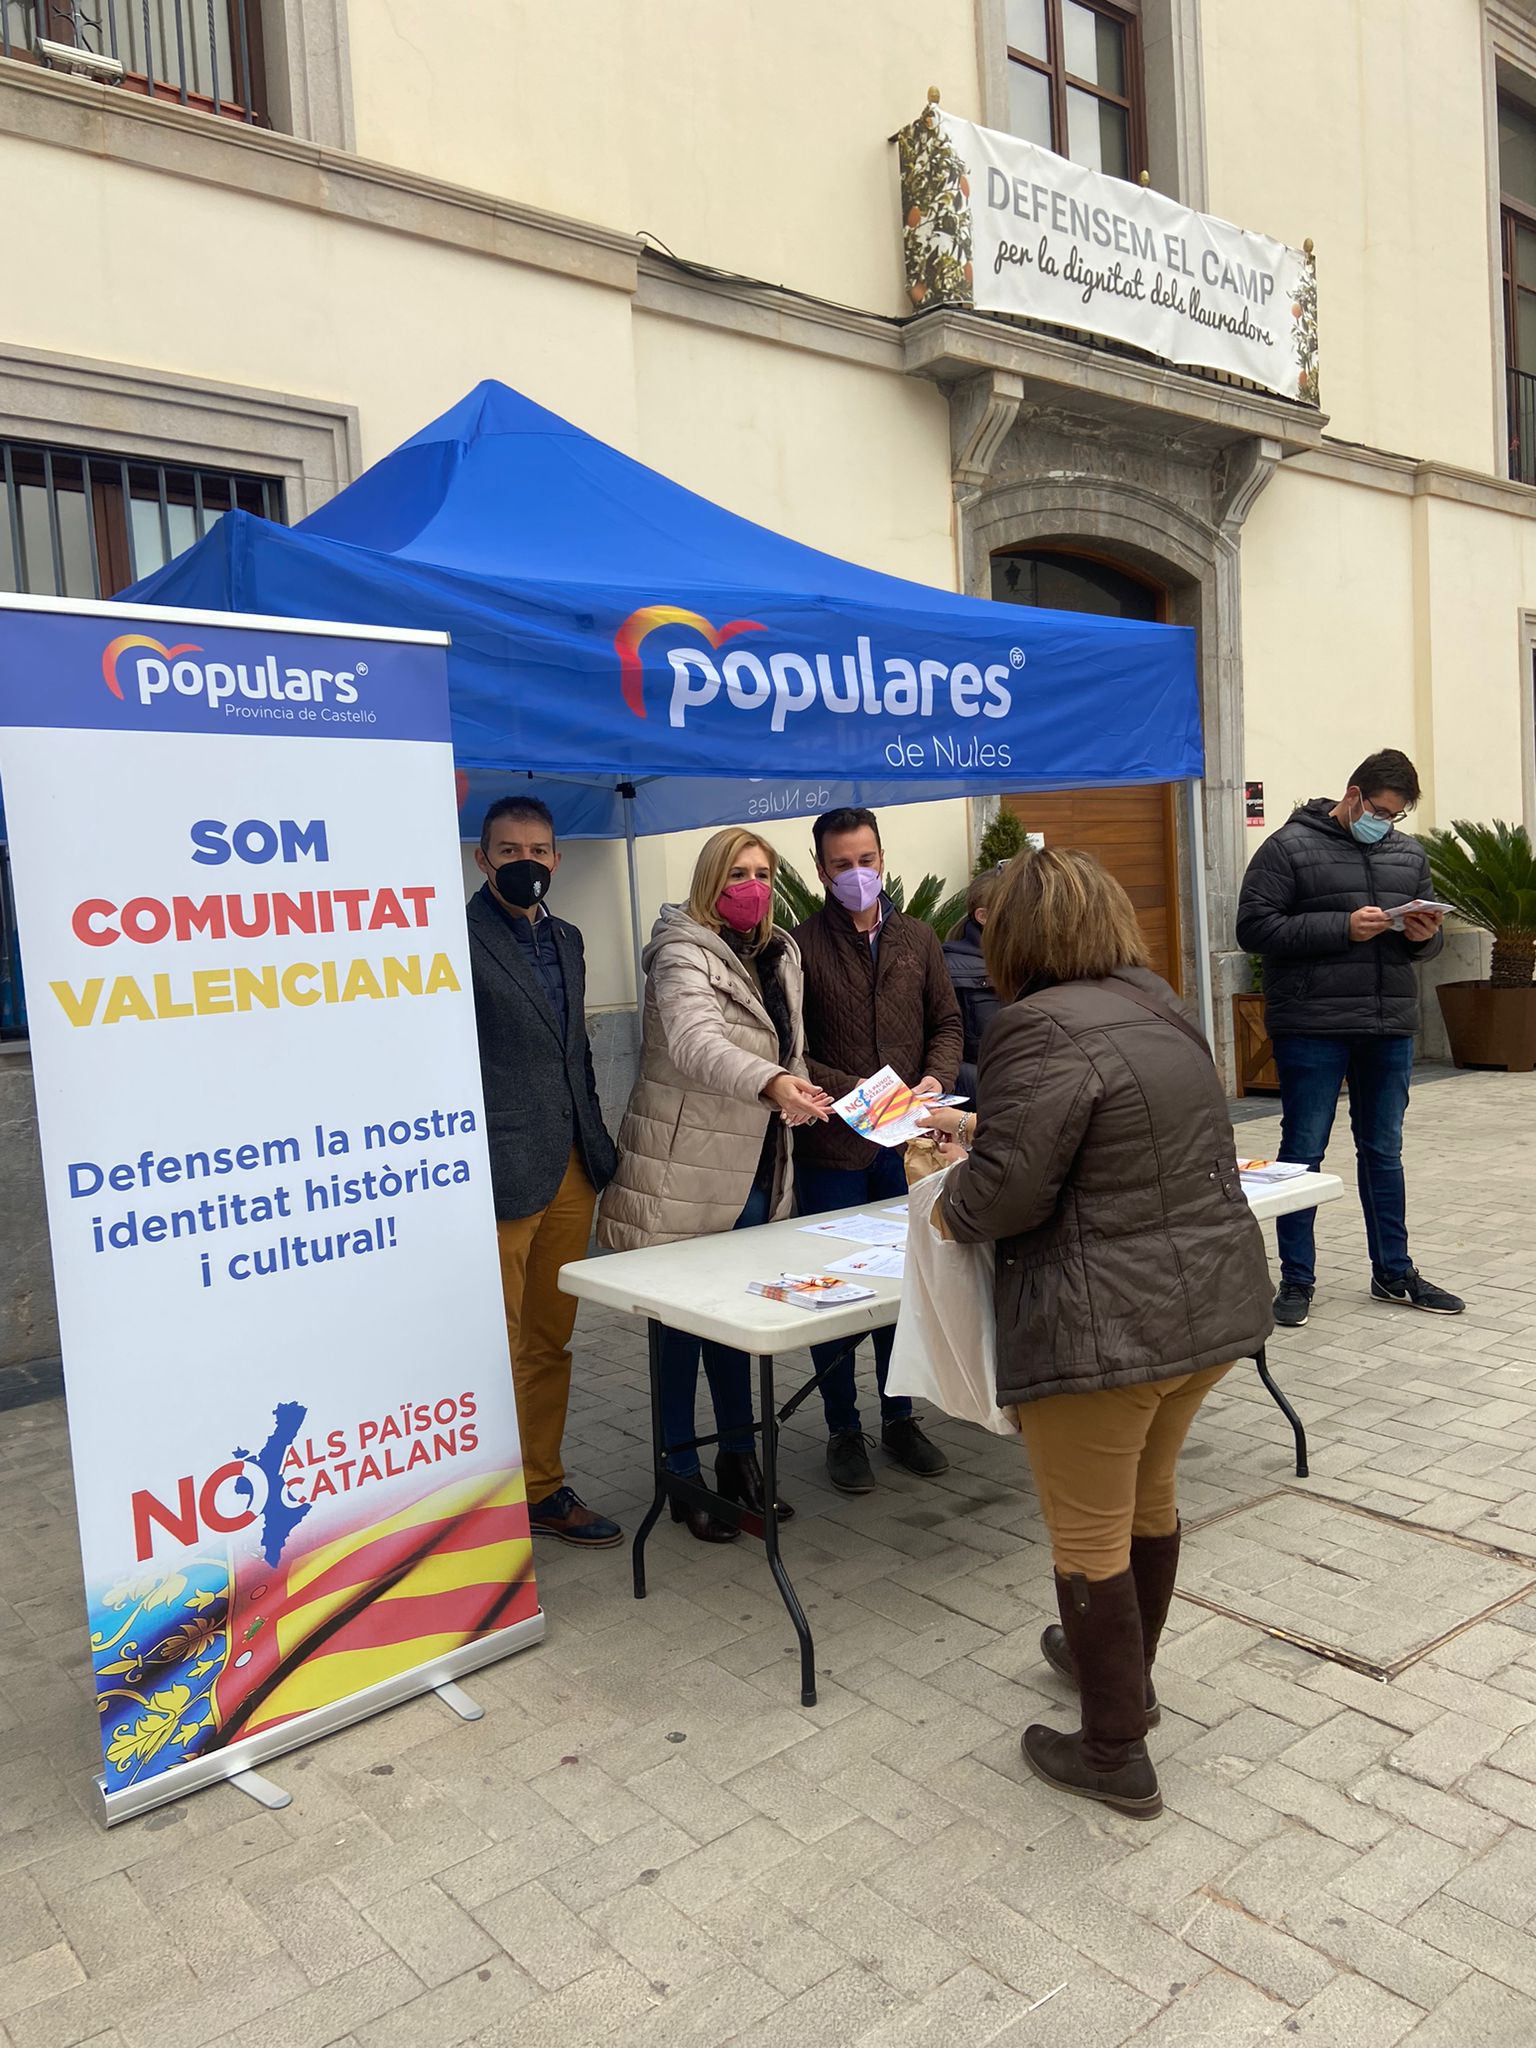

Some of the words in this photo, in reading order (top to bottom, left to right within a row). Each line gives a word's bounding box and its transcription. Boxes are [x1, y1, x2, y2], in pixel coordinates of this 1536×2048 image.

[987, 166, 1158, 263] DEFENSEM
[1163, 233, 1195, 279] EL
[1200, 249, 1275, 306] CAMP
[994, 238, 1033, 274] per
[1038, 235, 1059, 276] la
[1063, 245, 1146, 304] dignitat
[1150, 271, 1187, 315] dels
[1189, 290, 1274, 347] llauradors
[136, 655, 359, 709] populars
[225, 703, 294, 720] Provincia
[298, 707, 317, 721] de
[321, 708, 377, 723] Castelló
[666, 636, 1012, 733] populares
[885, 735, 924, 769] de
[933, 735, 1012, 769] Nules
[190, 819, 330, 866] SOM
[71, 886, 436, 947] COMUNITAT
[47, 952, 462, 1028] VALENCIANA
[66, 1133, 300, 1200] Defensem
[315, 1123, 350, 1159] la
[363, 1107, 477, 1150] nostra
[92, 1186, 291, 1253] identitat
[305, 1157, 471, 1213] històrica
[199, 1253, 212, 1288] i
[227, 1216, 398, 1281] cultural!
[281, 1430, 347, 1475] ALS
[358, 1391, 478, 1449] PAÏSOS
[281, 1422, 479, 1506] CATALANS
[131, 1457, 269, 1563] NO
